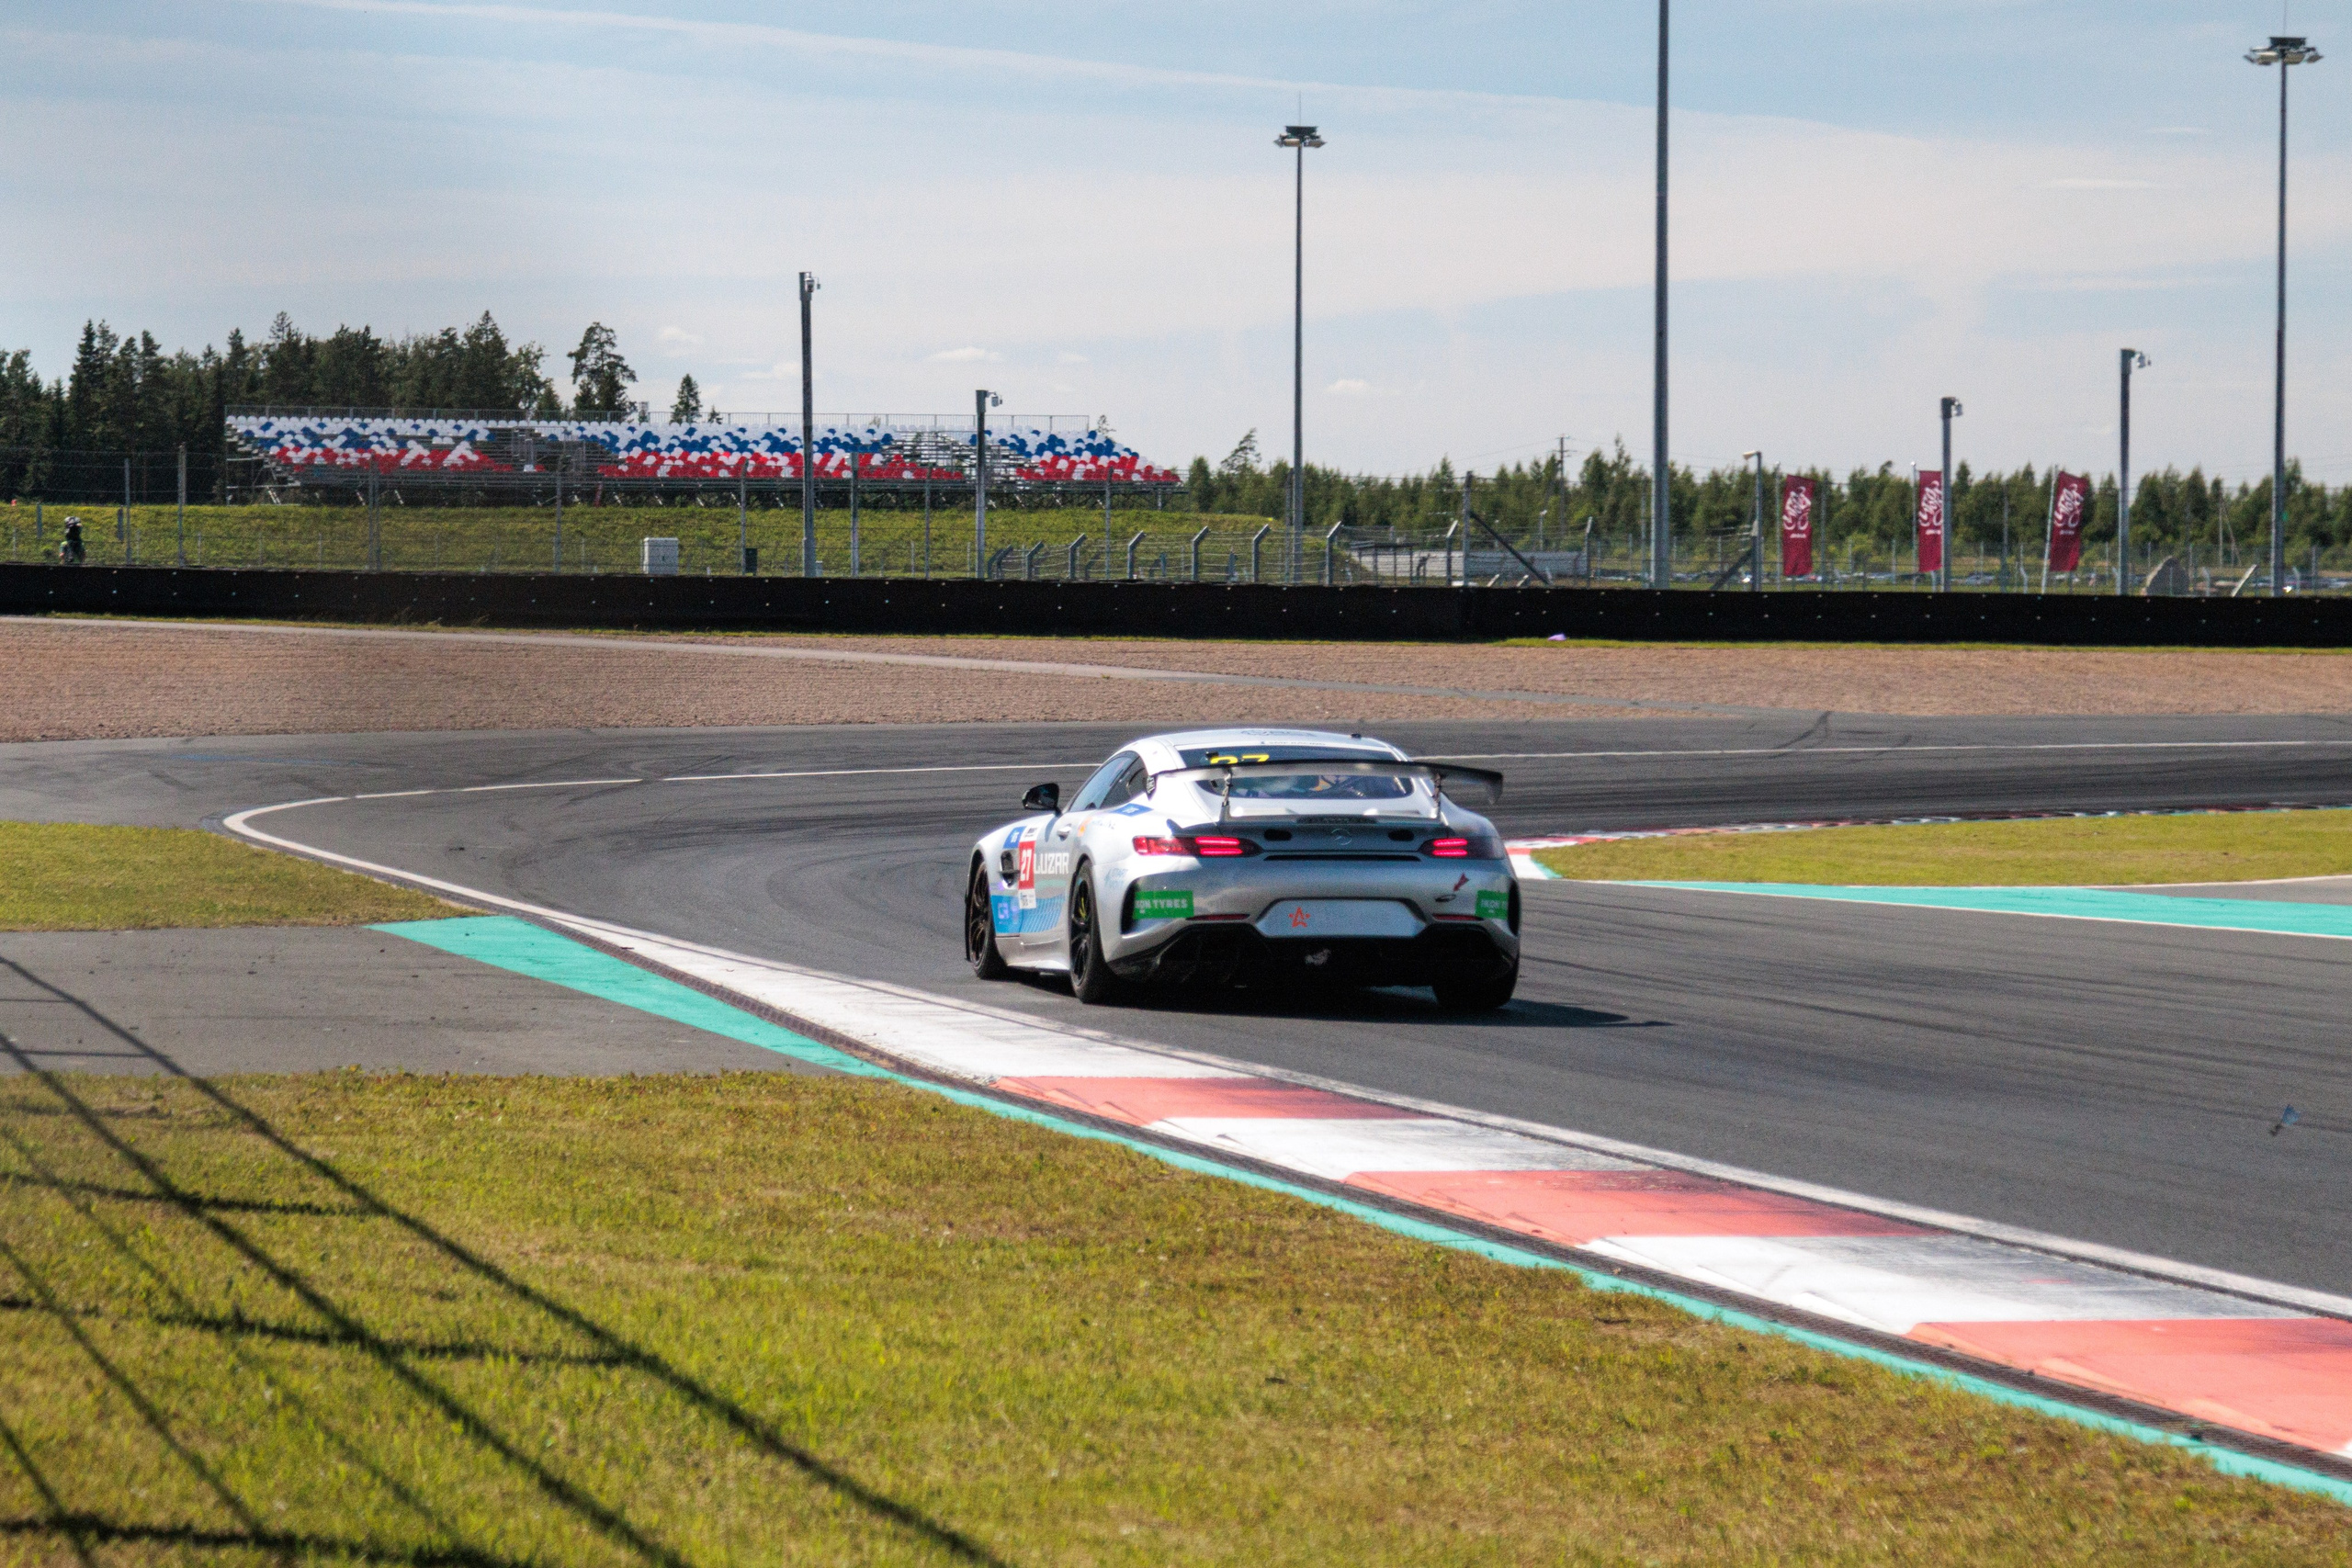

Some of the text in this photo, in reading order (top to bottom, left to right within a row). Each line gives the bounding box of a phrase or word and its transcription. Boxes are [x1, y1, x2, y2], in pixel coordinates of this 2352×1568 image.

[1021, 849, 1033, 882] 27
[1035, 852, 1069, 874] LUZAR
[1152, 898, 1188, 909] TYRES
